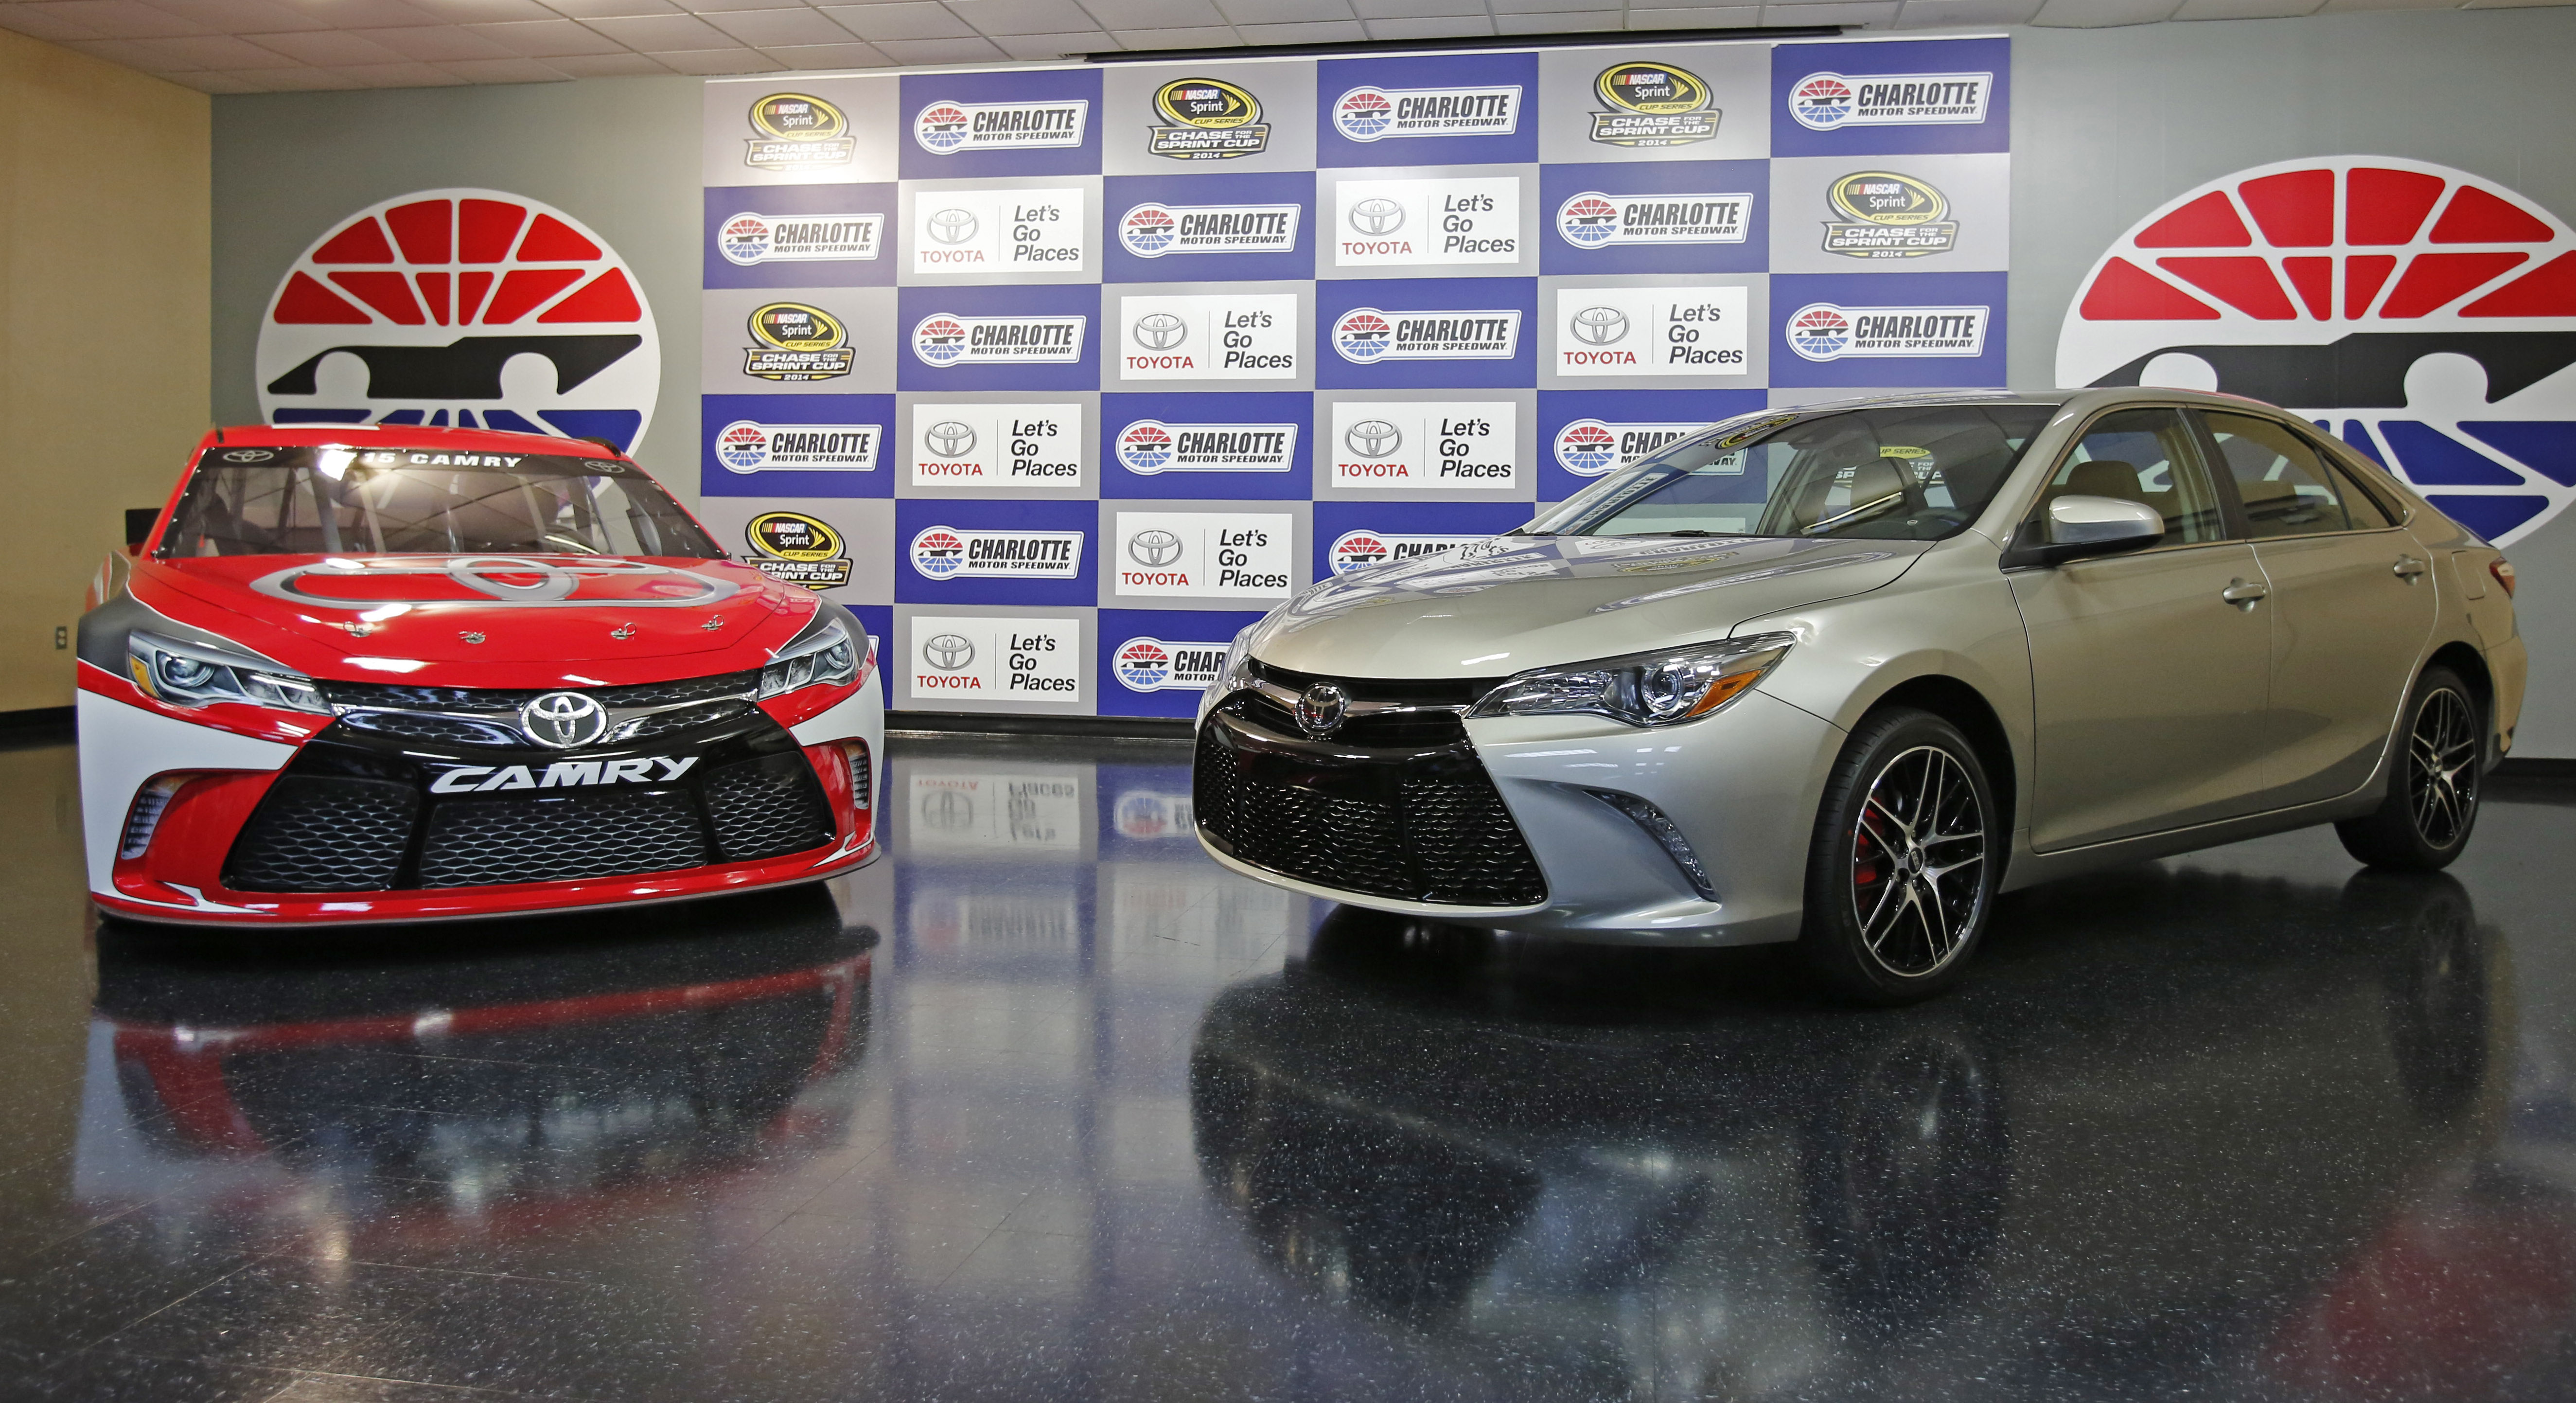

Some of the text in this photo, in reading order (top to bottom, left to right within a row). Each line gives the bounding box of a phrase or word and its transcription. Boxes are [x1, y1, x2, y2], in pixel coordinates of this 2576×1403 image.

[1628, 73, 1665, 85] NASCAR
[1185, 89, 1218, 100] NASCAR
[1635, 86, 1670, 100] Sprint
[1858, 82, 1978, 107] CHARLOTTE
[778, 104, 809, 114] NASCAR
[1191, 101, 1223, 115] Sprint
[1397, 95, 1509, 119] CHARLOTTE
[1858, 106, 1976, 116] MOTOR SPEEDWAY
[783, 115, 813, 128] Sprint
[973, 109, 1076, 133] CHARLOTTE
[1444, 118, 1507, 126] SPEEDWAY
[1612, 117, 1681, 127] CHASE
[1016, 131, 1074, 140] SPEEDWAY
[1169, 131, 1233, 141] CHASE
[1599, 125, 1710, 136] SPRINT CUP
[763, 143, 822, 153] CHASE
[1157, 139, 1259, 149] SPRINT CUP
[753, 152, 812, 161] SPRINT
[1863, 183, 1900, 195] NASCAR
[1444, 194, 1493, 212] Let's
[1869, 196, 1906, 210] Sprint
[1014, 205, 1059, 222] Let's
[1623, 203, 1739, 226] CHARLOTTE
[1181, 213, 1288, 236] CHARLOTTE
[1443, 215, 1473, 232] Go
[775, 223, 872, 244] CHARLOTTE
[1013, 225, 1041, 242] Go
[1845, 228, 1917, 237] CHASE
[1342, 241, 1412, 255] TOYOTA
[1444, 235, 1515, 253] Places
[1832, 237, 1947, 246] SPRINT CUP
[921, 250, 984, 263] TOYOTA
[1013, 245, 1079, 261] Places
[776, 314, 807, 323] NASCAR
[1224, 311, 1272, 328] Let's
[1669, 304, 1720, 322] Let's
[782, 325, 812, 337] Sprint
[1396, 320, 1508, 342] CHARLOTTE
[1668, 325, 1699, 342] Go
[1855, 316, 1975, 338] CHARLOTTE
[971, 325, 1074, 346] CHARLOTTE
[1223, 331, 1252, 348] Go
[762, 354, 821, 362] CHASE
[1127, 356, 1194, 369] TOYOTA
[1224, 351, 1292, 368] Places
[1564, 351, 1636, 365] TOYOTA
[1669, 346, 1743, 363] Places
[1012, 420, 1057, 437] Let's
[1441, 419, 1490, 436] Let's
[772, 433, 870, 453] CHARLOTTE
[1011, 439, 1038, 456] Go
[1178, 432, 1285, 454] CHARLOTTE
[1440, 439, 1469, 456] Go
[410, 454, 522, 468] CAMRY
[1012, 459, 1076, 476] Places
[1440, 460, 1511, 477] Places
[918, 463, 982, 476] TOYOTA
[1339, 464, 1408, 477] TOYOTA
[775, 523, 805, 533] NASCAR
[780, 534, 810, 547] Sprint
[1220, 529, 1267, 547] Let's
[969, 539, 1071, 560] CHARLOTTE
[1218, 549, 1247, 566] Go
[760, 563, 819, 571] CHASE
[772, 571, 808, 580] RINT
[1122, 572, 1189, 586] TOYOTA
[1219, 569, 1288, 587] Places
[1010, 634, 1056, 651] Let's
[1009, 654, 1037, 670] Go
[917, 675, 981, 689] TOYOTA
[1010, 673, 1075, 691] Places
[431, 757, 699, 793] CAMRY
